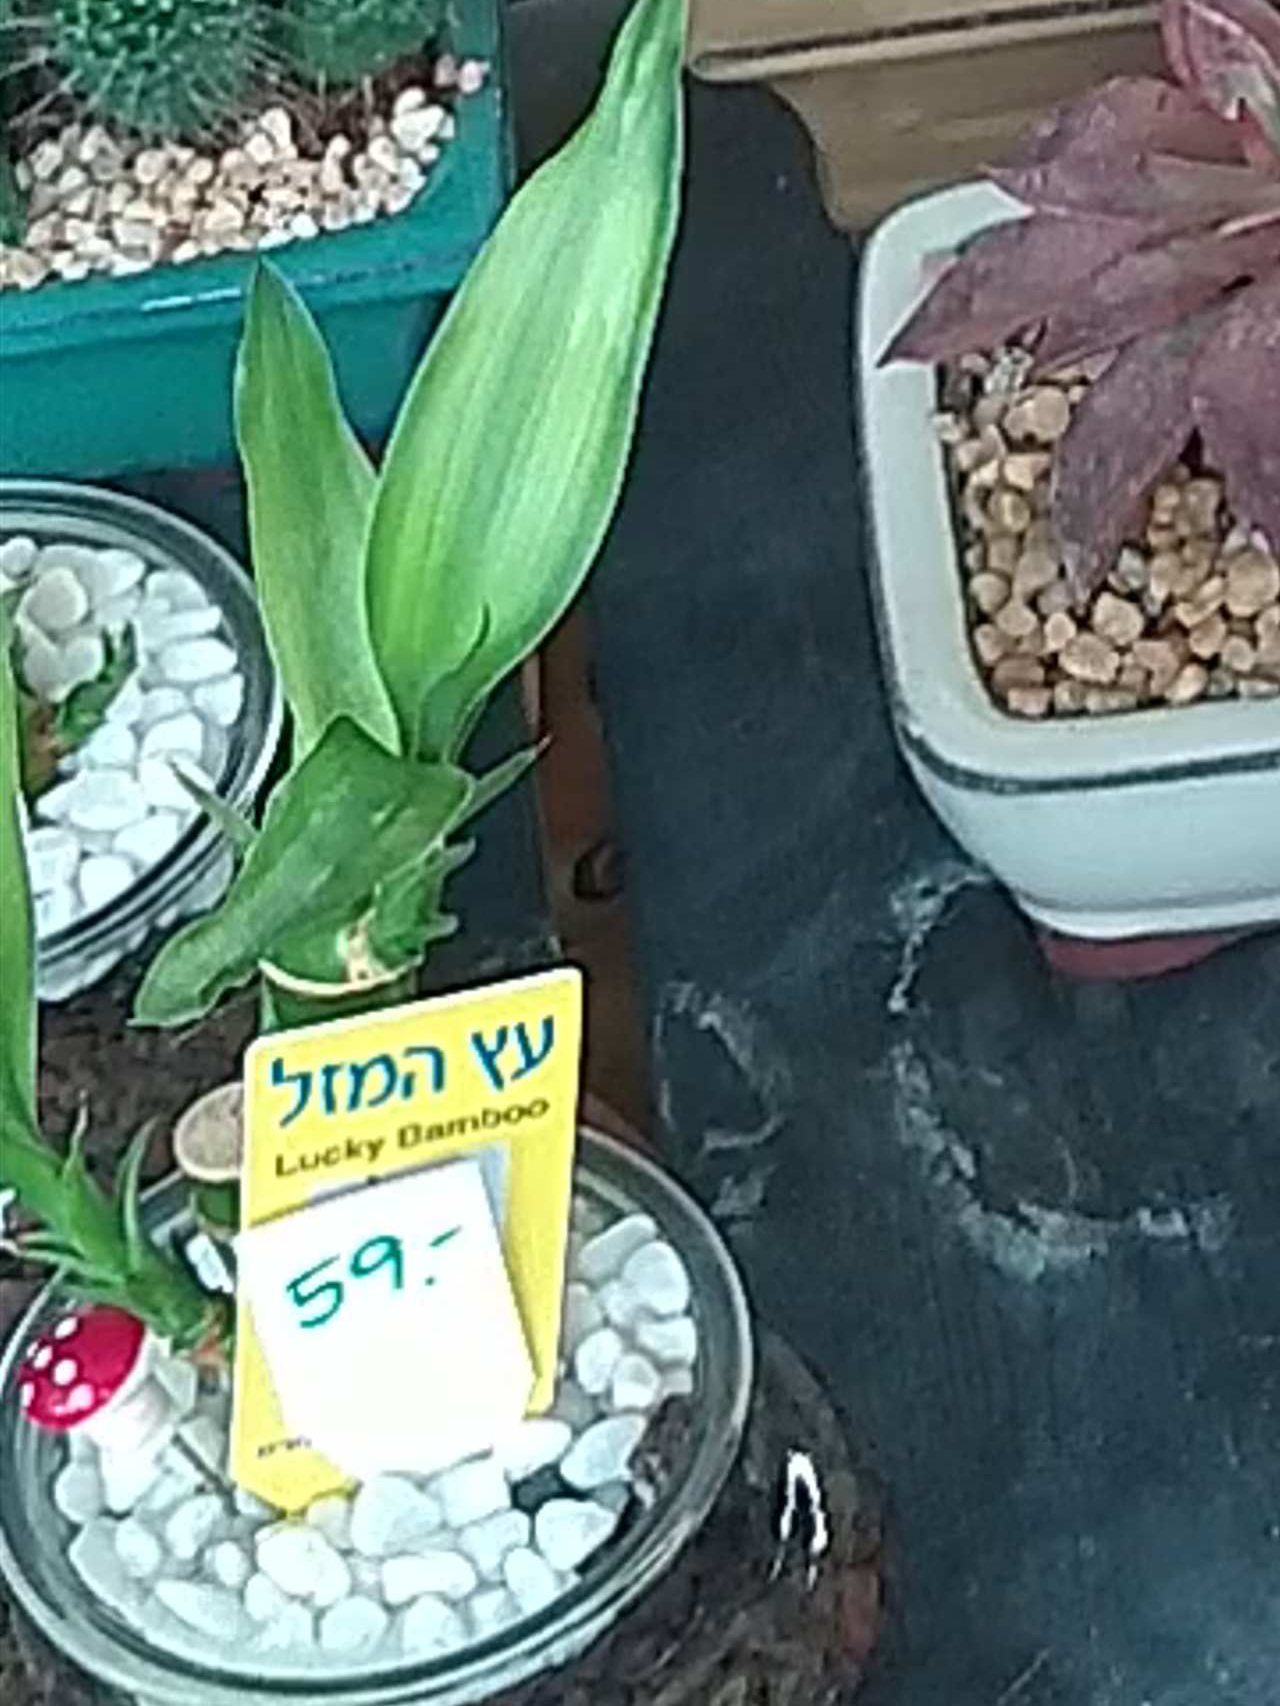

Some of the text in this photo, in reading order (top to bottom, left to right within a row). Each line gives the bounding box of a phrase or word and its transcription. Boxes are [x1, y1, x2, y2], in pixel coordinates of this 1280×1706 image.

[269, 1014, 556, 1129] עץ המזל
[275, 1097, 551, 1178] Lucky Bamboo
[286, 1225, 462, 1330] 59.-
